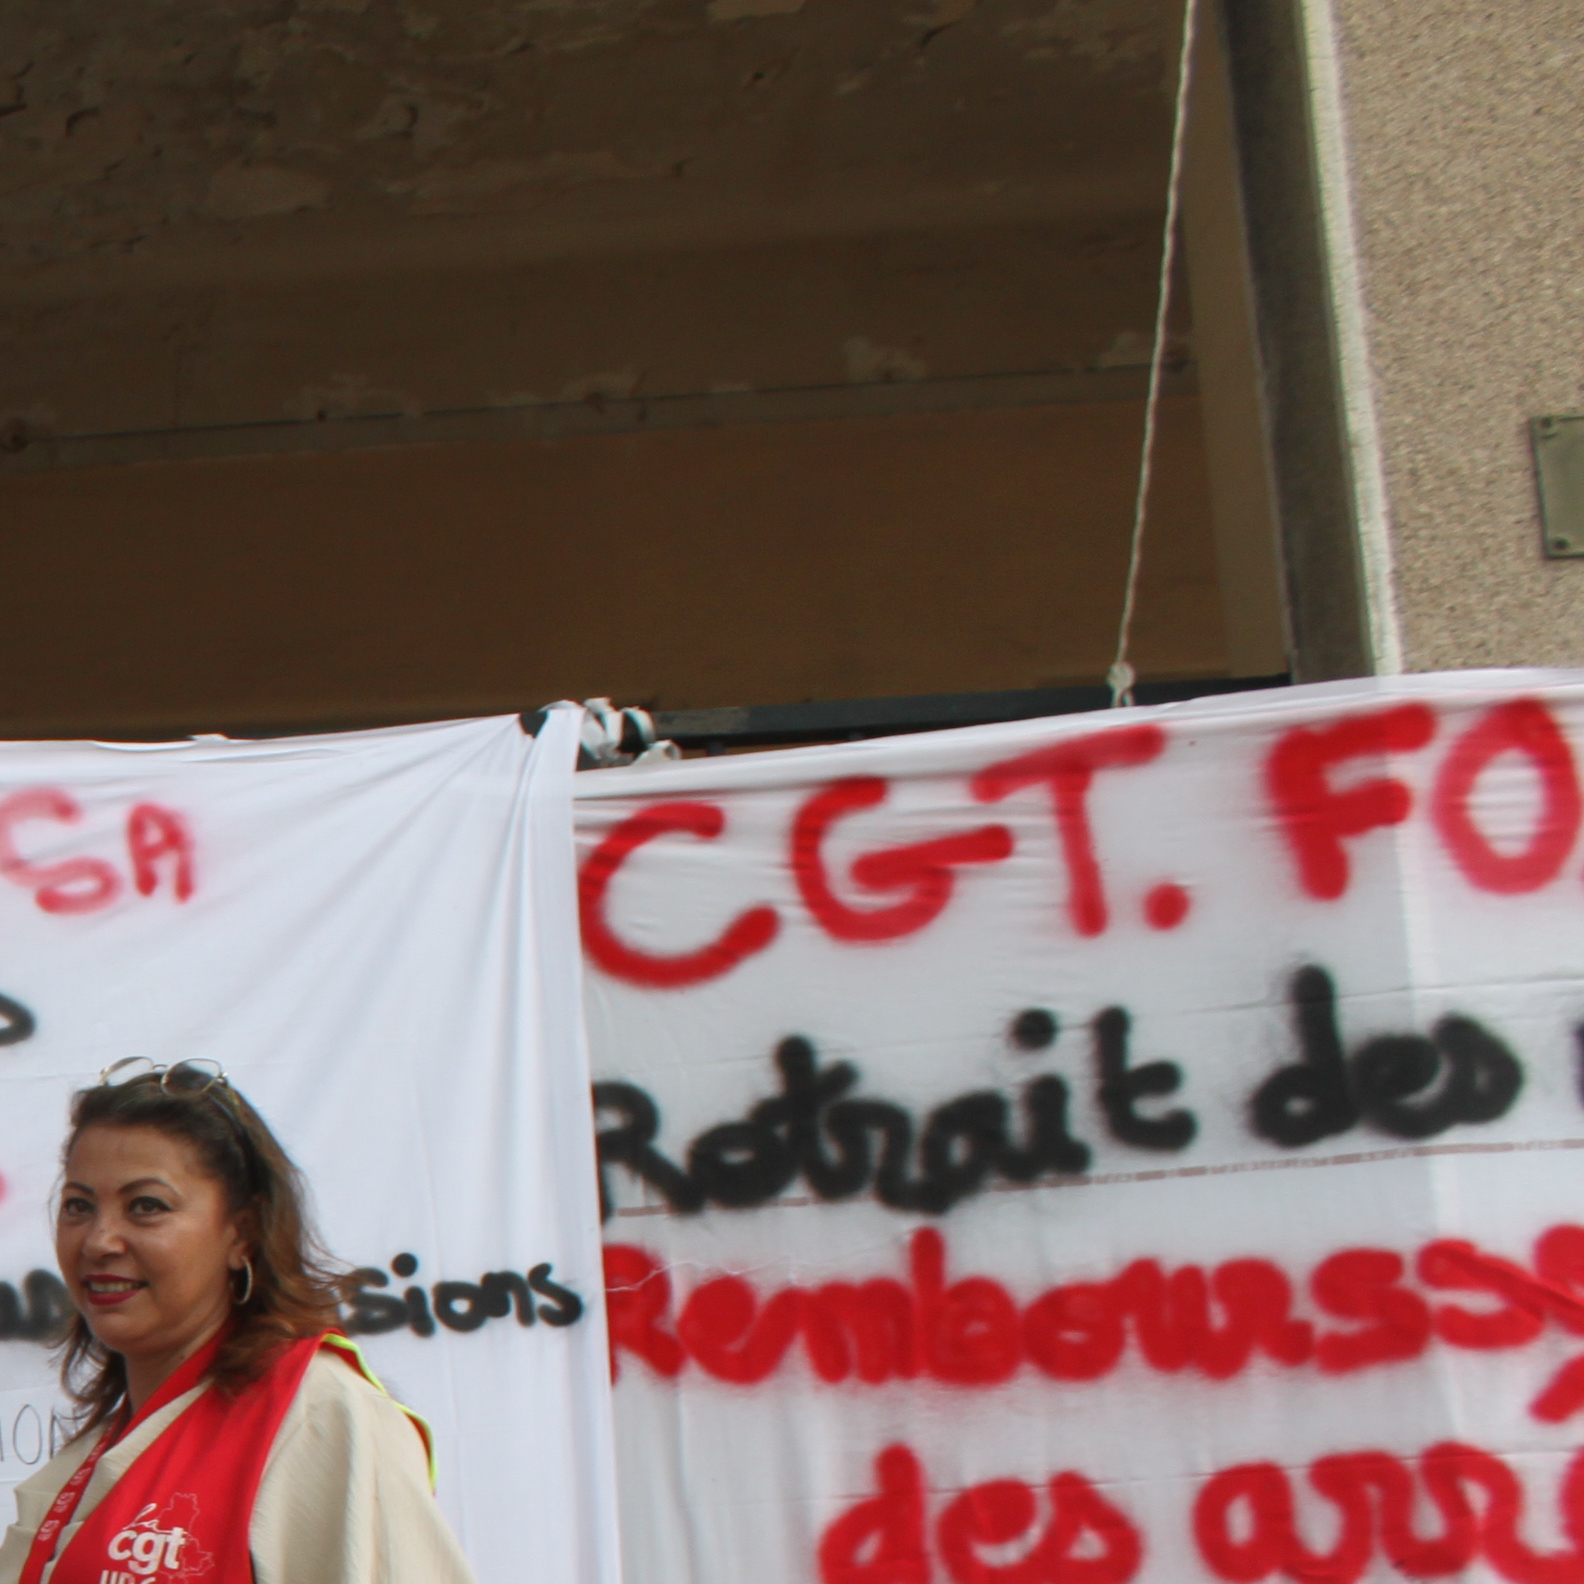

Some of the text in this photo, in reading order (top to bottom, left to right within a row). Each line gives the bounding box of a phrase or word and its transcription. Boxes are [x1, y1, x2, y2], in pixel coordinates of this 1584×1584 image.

[1266, 696, 1581, 902] FO
[1249, 962, 1524, 1148] des
[107, 1526, 186, 1575] cgt
